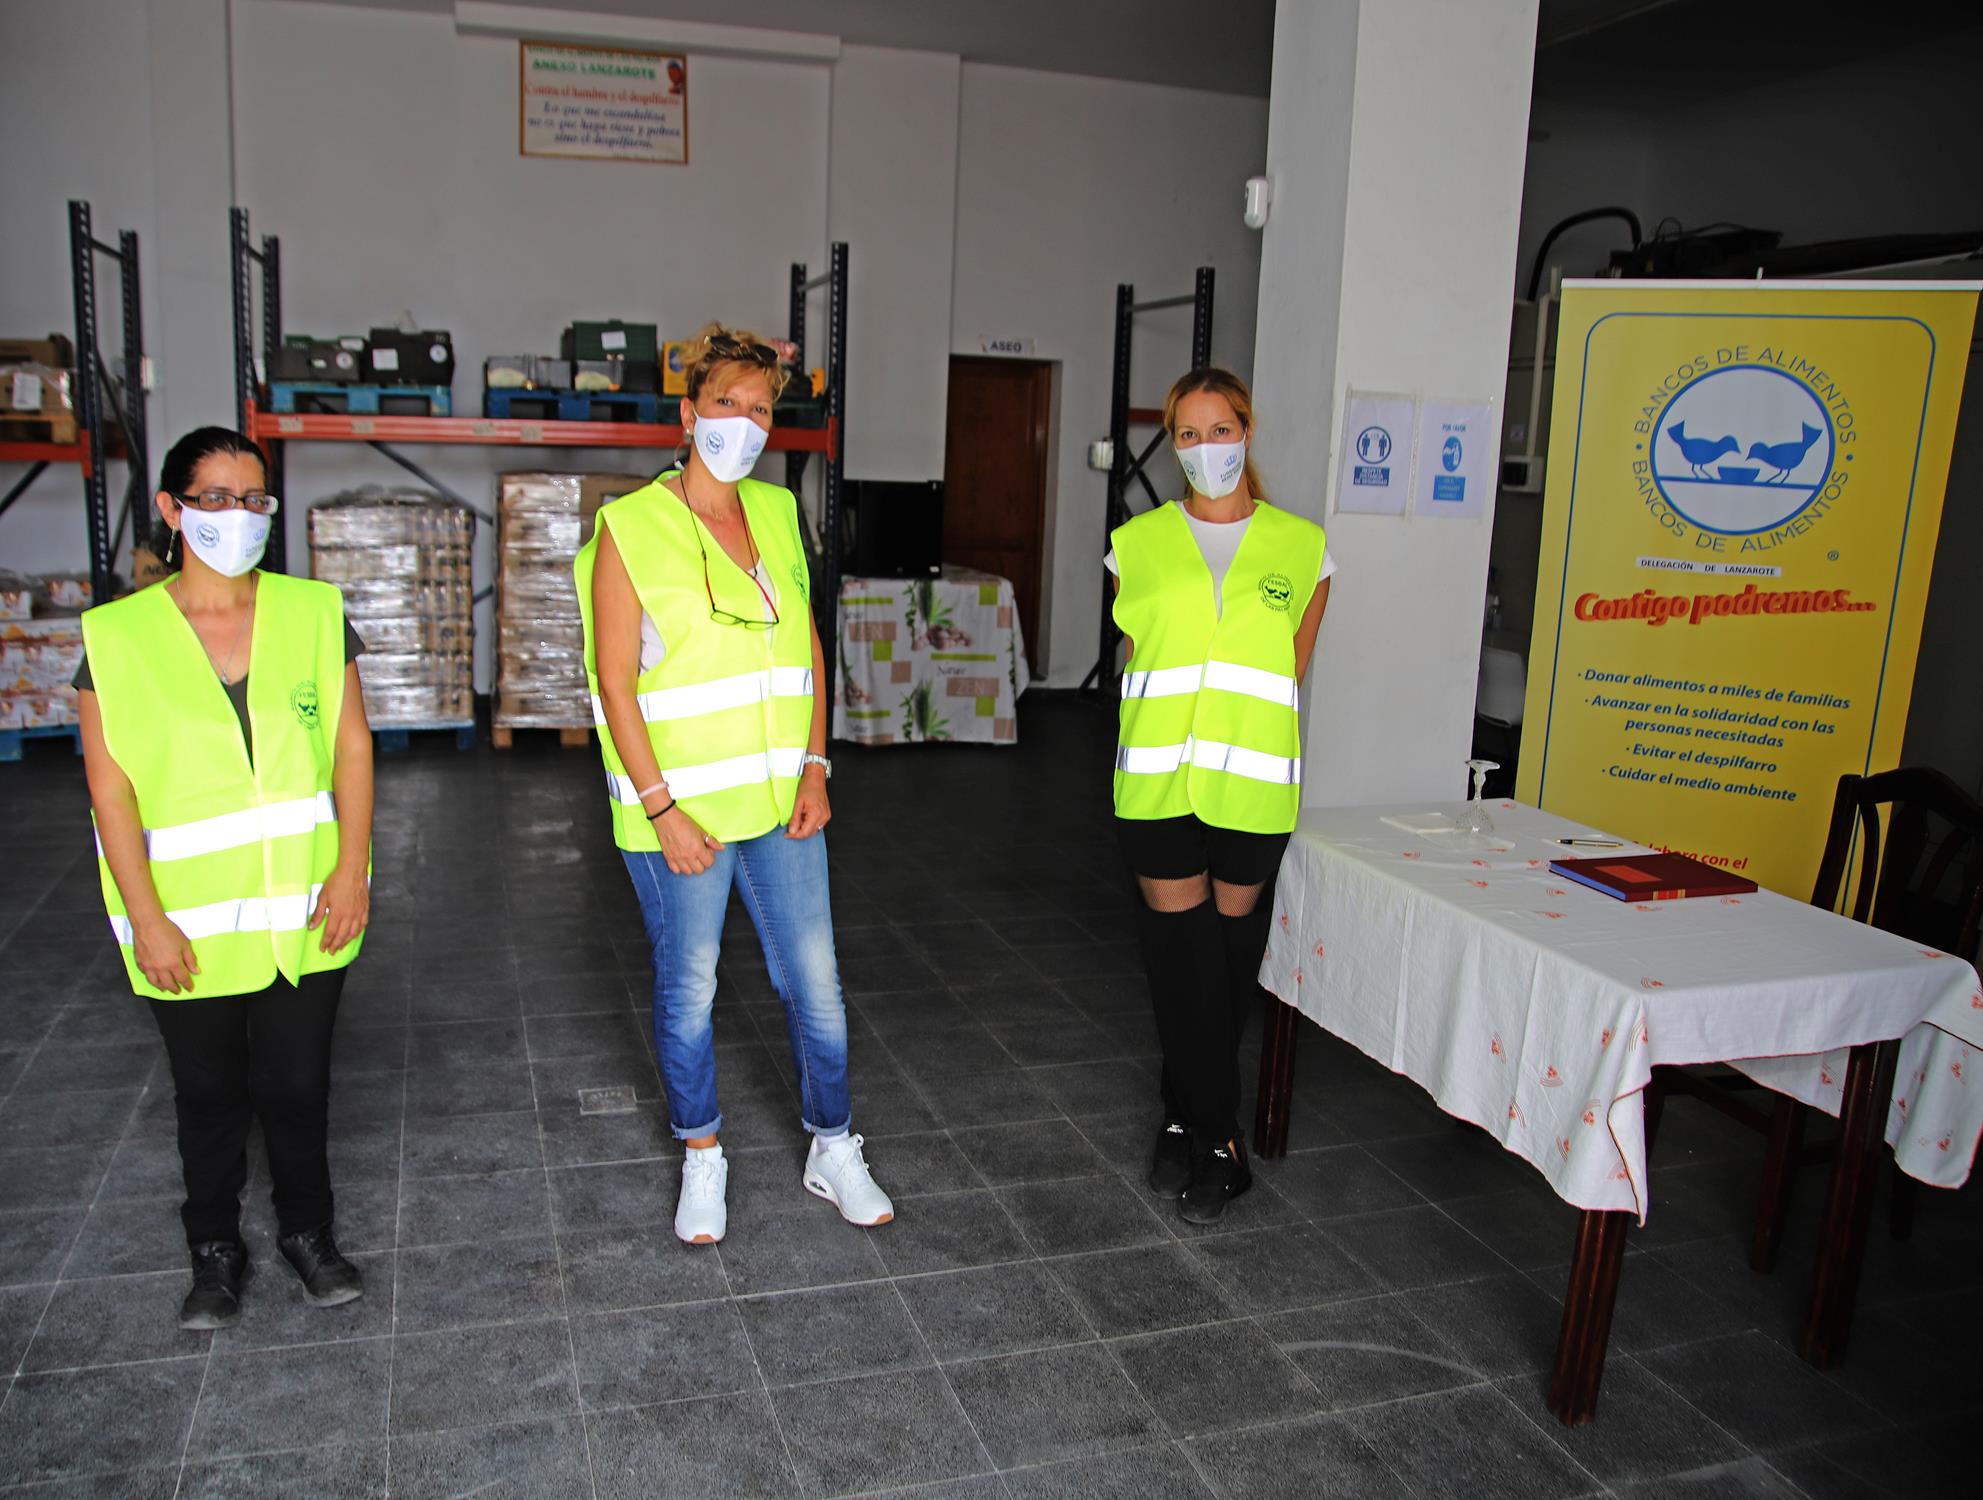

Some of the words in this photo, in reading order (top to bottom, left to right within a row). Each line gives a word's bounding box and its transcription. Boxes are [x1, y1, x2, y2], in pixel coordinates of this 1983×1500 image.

[581, 63, 656, 79] LANZAROTE
[990, 340, 1022, 352] ASEO
[1634, 356, 1709, 434] BANCOS
[1717, 345, 1749, 364] DE
[1757, 347, 1857, 444] ALIMENTOS
[1632, 460, 1688, 538] BANCOS
[1695, 533, 1728, 553] DE
[1740, 471, 1849, 553] ALIMENTOS
[1640, 558, 1694, 571] DELEGACIÓN
[1704, 564, 1716, 573] DE
[1724, 565, 1776, 577] LANZAROTE
[1574, 589, 1690, 627] Contigo
[1584, 668, 1631, 684] Donar
[1633, 674, 1706, 693] alimentos
[1708, 684, 1719, 695] a
[1721, 684, 1762, 699] miles
[1764, 688, 1784, 702] de
[1786, 690, 1851, 709] familias
[1591, 695, 1652, 712] Avanzar
[1654, 704, 1672, 715] en
[1674, 703, 1689, 717] la
[1692, 707, 1780, 728] solidaridad
[1781, 719, 1809, 731] con
[1811, 719, 1836, 734] las
[1625, 719, 1692, 737] personas
[1694, 728, 1784, 748] necesitadas
[1632, 743, 1677, 760] Evitar
[1678, 750, 1693, 762] el
[1694, 751, 1777, 773] despilfarro
[1609, 765, 1657, 782] Cuidar
[1659, 773, 1673, 785] el
[1674, 776, 1721, 791] medio
[1724, 782, 1797, 802] ambiente
[1700, 853, 1729, 868] con
[1732, 857, 1749, 870] el
